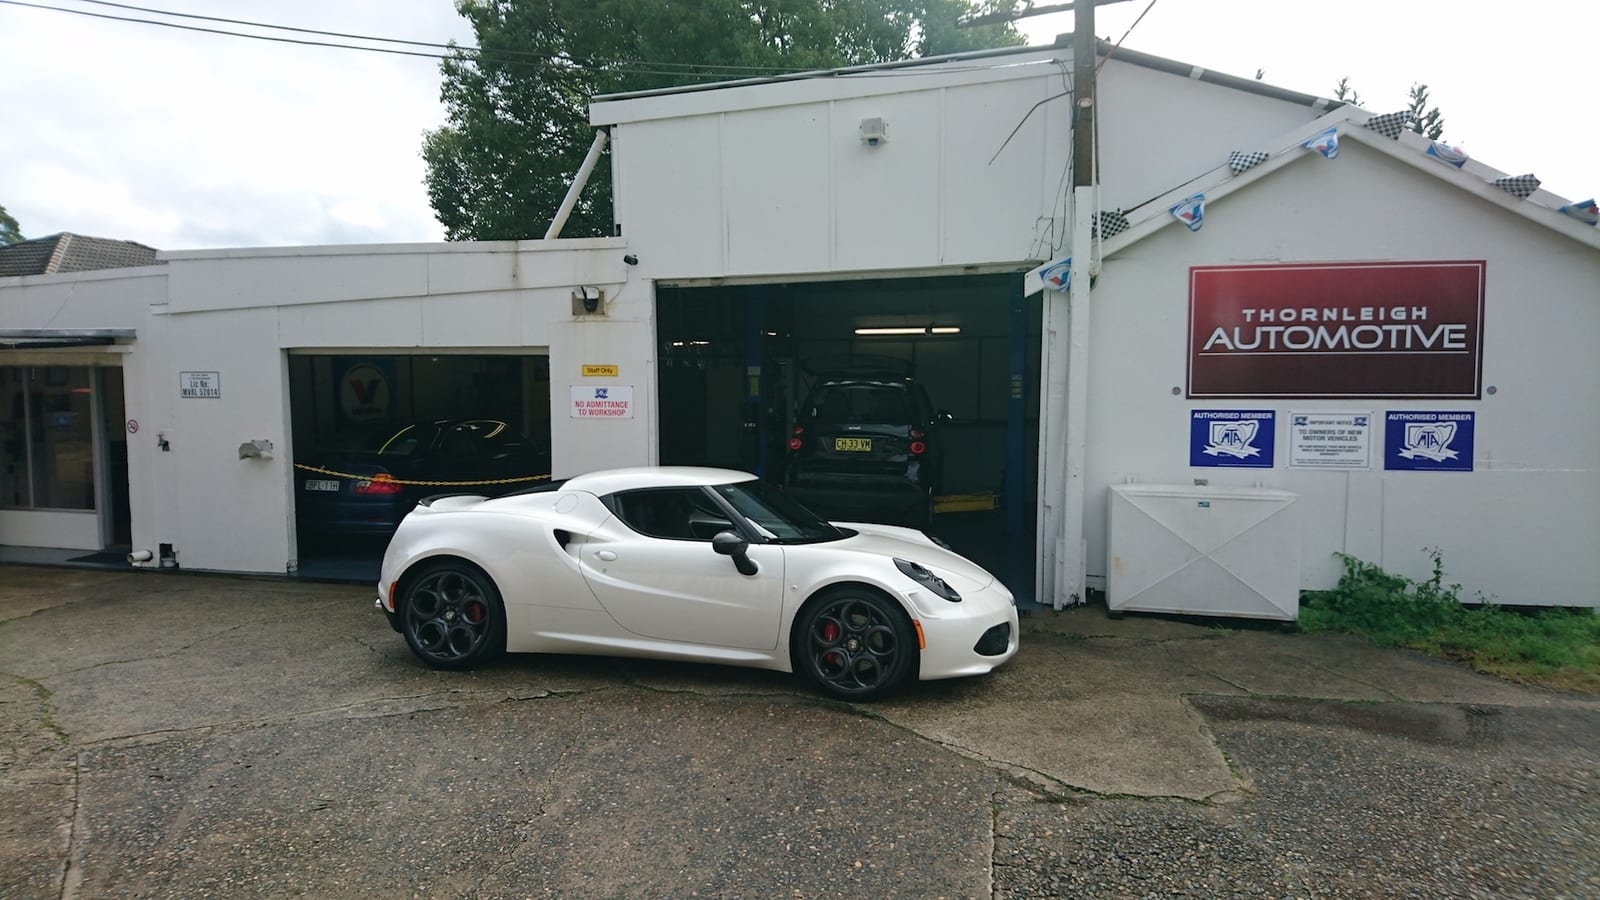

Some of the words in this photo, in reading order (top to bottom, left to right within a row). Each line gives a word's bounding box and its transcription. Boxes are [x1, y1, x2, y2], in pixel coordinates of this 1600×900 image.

[1242, 306, 1427, 322] THORNLEIGH
[1202, 324, 1467, 350] AUTOMOTIVE
[586, 401, 629, 409] ADMITTANCE
[578, 408, 587, 416] TO
[1240, 412, 1273, 420] MEMBER
[1388, 413, 1437, 421] AUTHORISED
[1438, 413, 1472, 422] MEMBER
[1220, 429, 1243, 446] MTA
[1417, 431, 1440, 449] MTA
